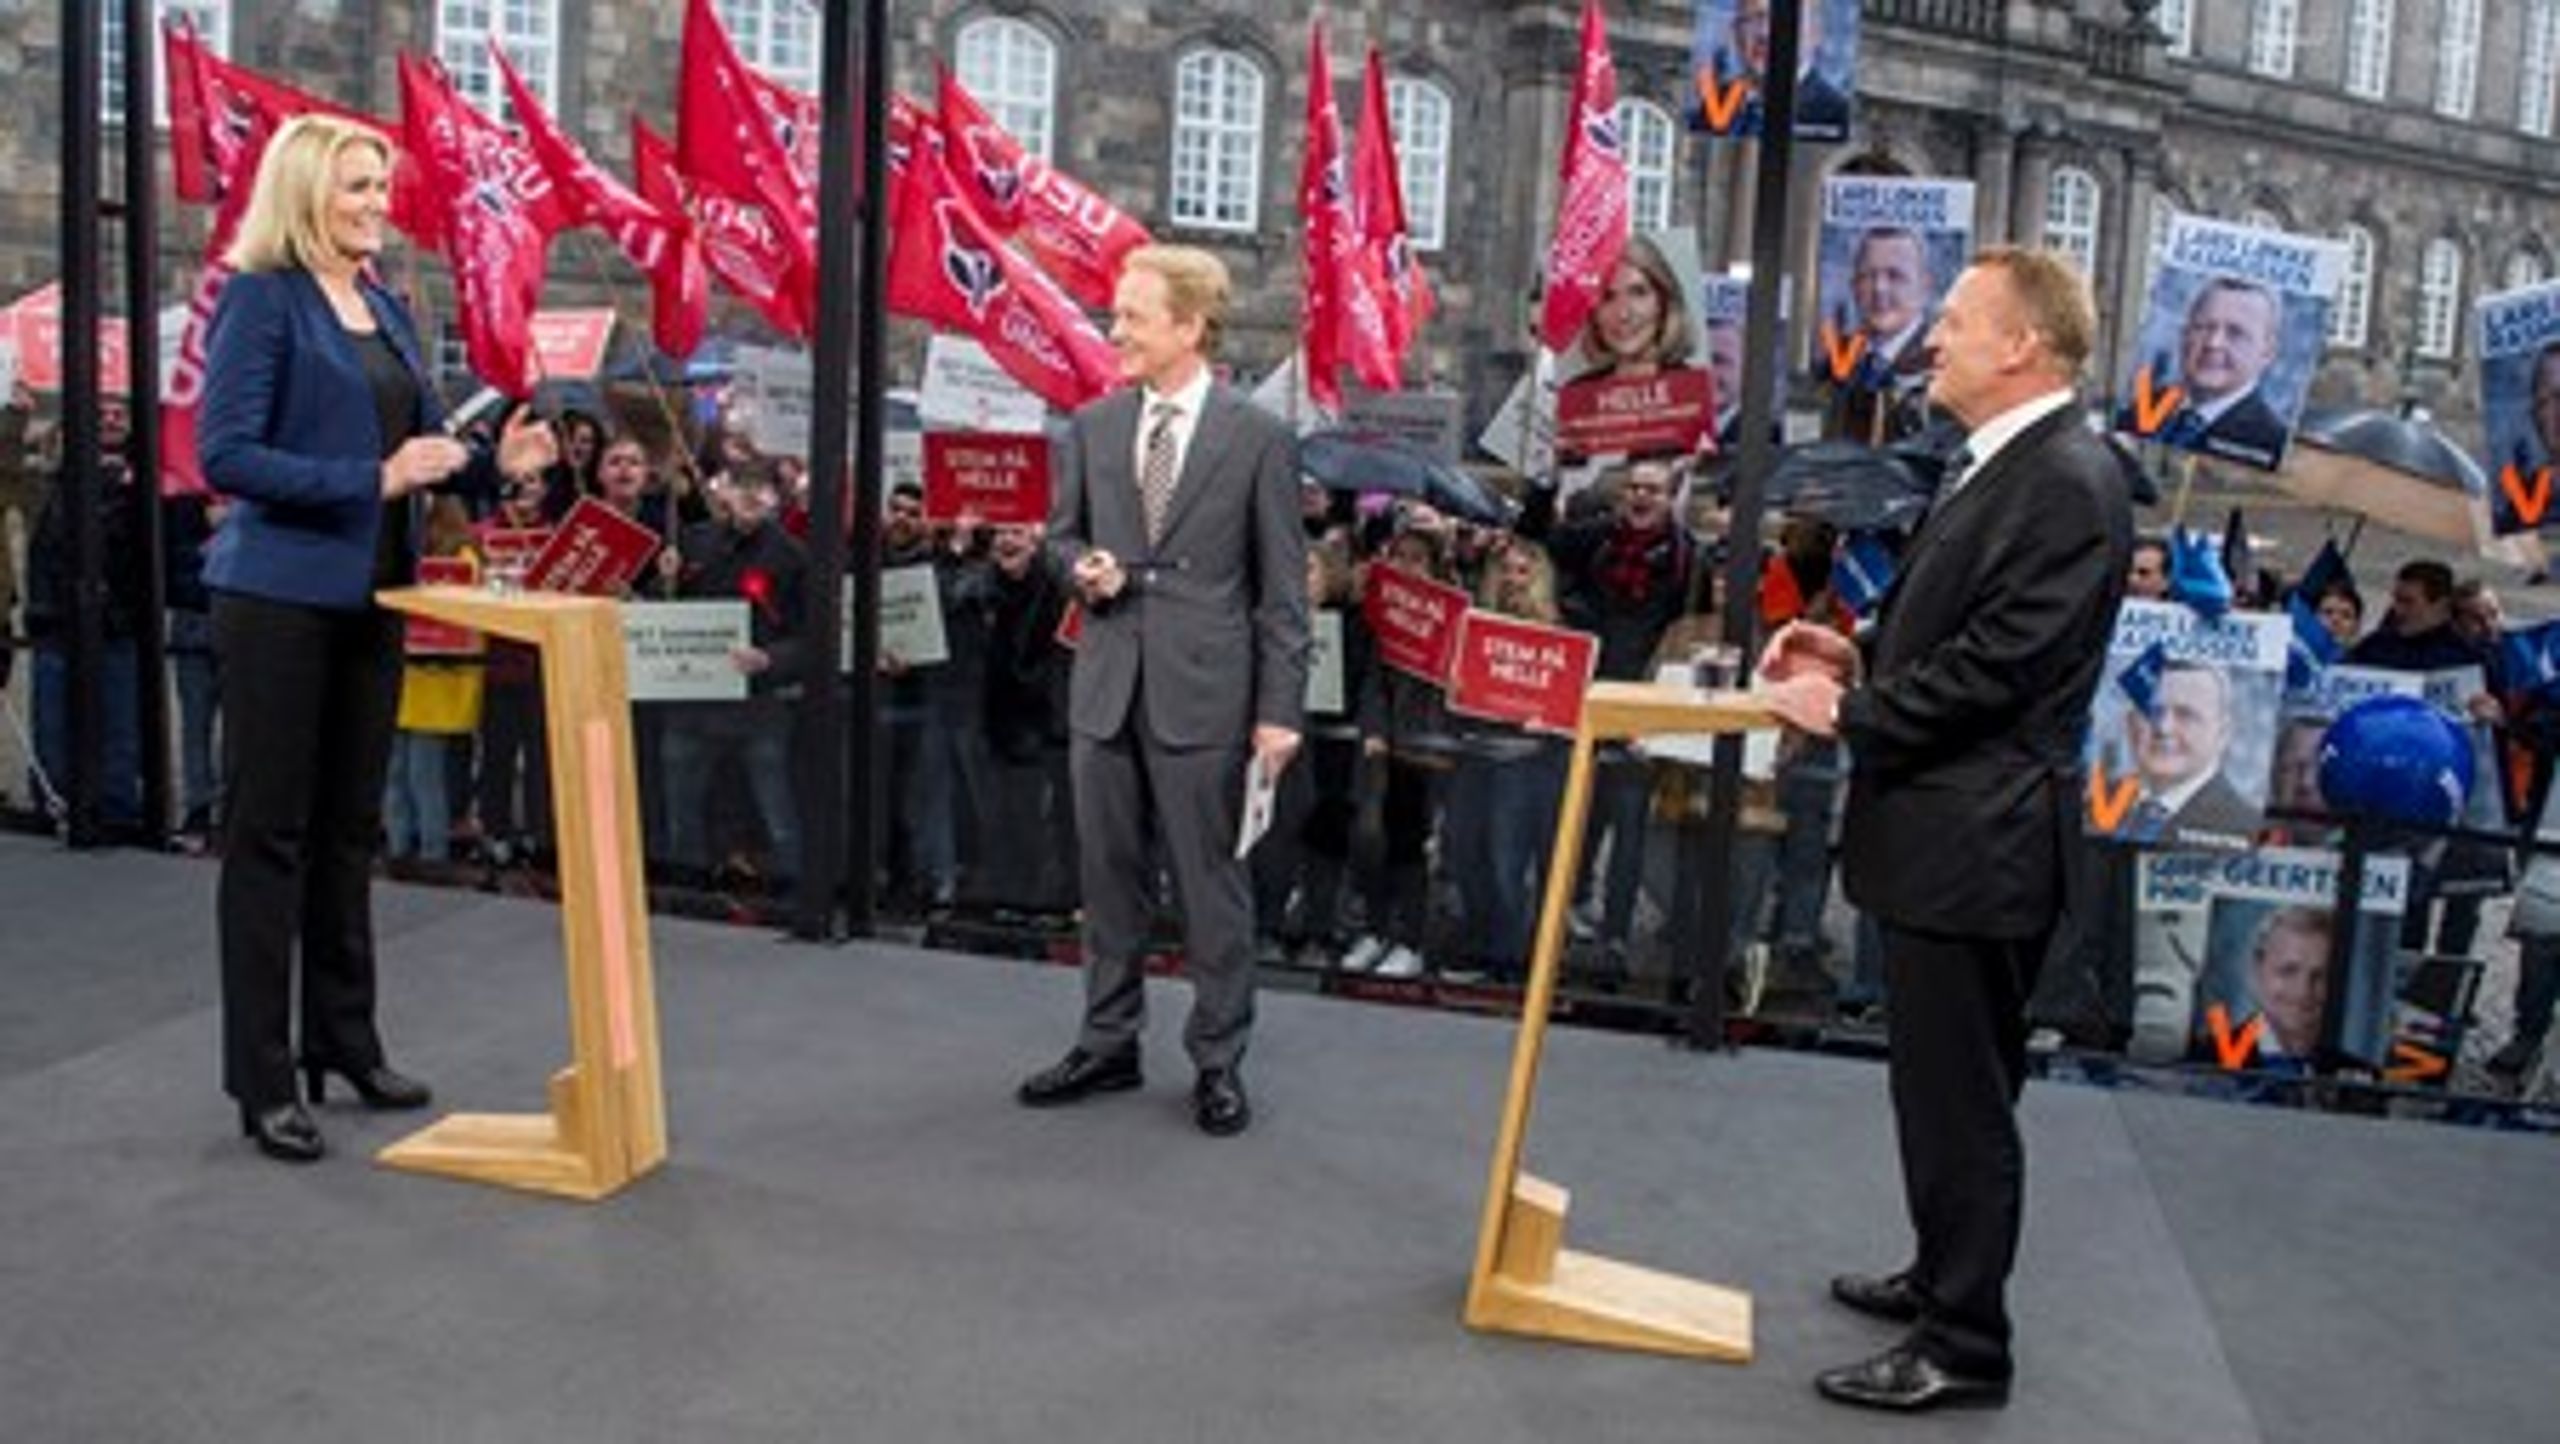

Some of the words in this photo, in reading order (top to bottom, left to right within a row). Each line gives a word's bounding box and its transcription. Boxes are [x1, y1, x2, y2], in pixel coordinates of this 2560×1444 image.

[2177, 226, 2237, 252] LARS
[2240, 236, 2324, 267] LØKKE
[2171, 247, 2318, 290] RASMUSSEN
[1597, 379, 1671, 411] HELLE
[945, 449, 997, 467] STEM
[956, 470, 1017, 489] HELLE
[1381, 582, 1424, 611] STEM
[1385, 606, 1434, 640] HELLE
[2122, 608, 2170, 632] ARS
[1484, 636, 1536, 660] STEM
[1540, 641, 1566, 669] PÅ
[1491, 660, 1550, 690] HELLE
[2223, 855, 2398, 899] GEERTEN
